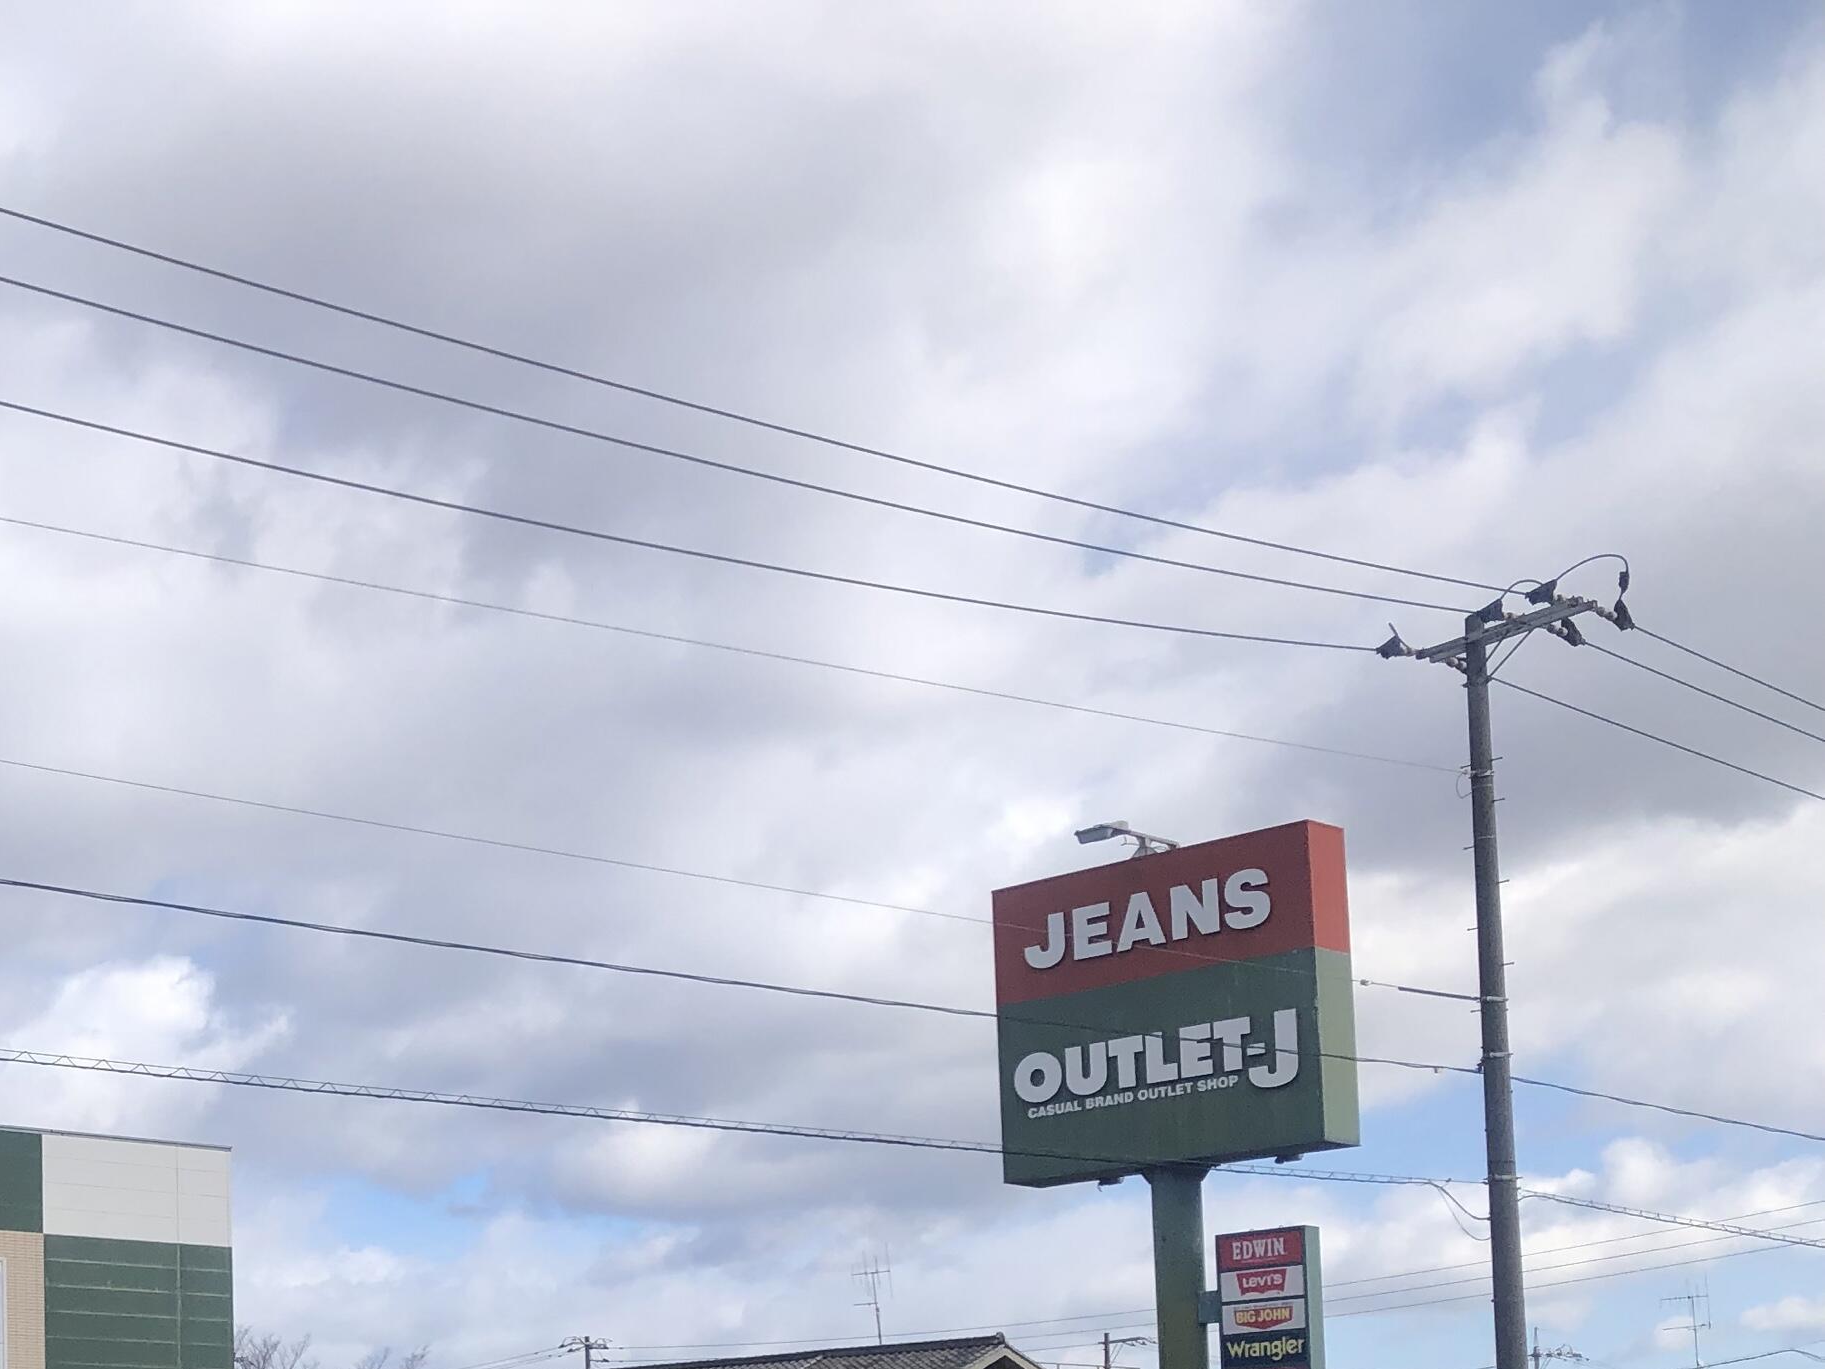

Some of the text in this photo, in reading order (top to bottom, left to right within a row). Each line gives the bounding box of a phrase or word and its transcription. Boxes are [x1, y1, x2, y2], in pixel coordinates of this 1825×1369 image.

[1023, 868, 1271, 970] JEANS
[1013, 1007, 1300, 1103] OUTLET-J
[1027, 1075, 1239, 1120] CASUAL BRAND OUTLET SHOP
[1232, 1237, 1286, 1261] EDWIN
[1235, 1307, 1290, 1324] BIG JOHN
[1226, 1337, 1305, 1361] Wrangler
